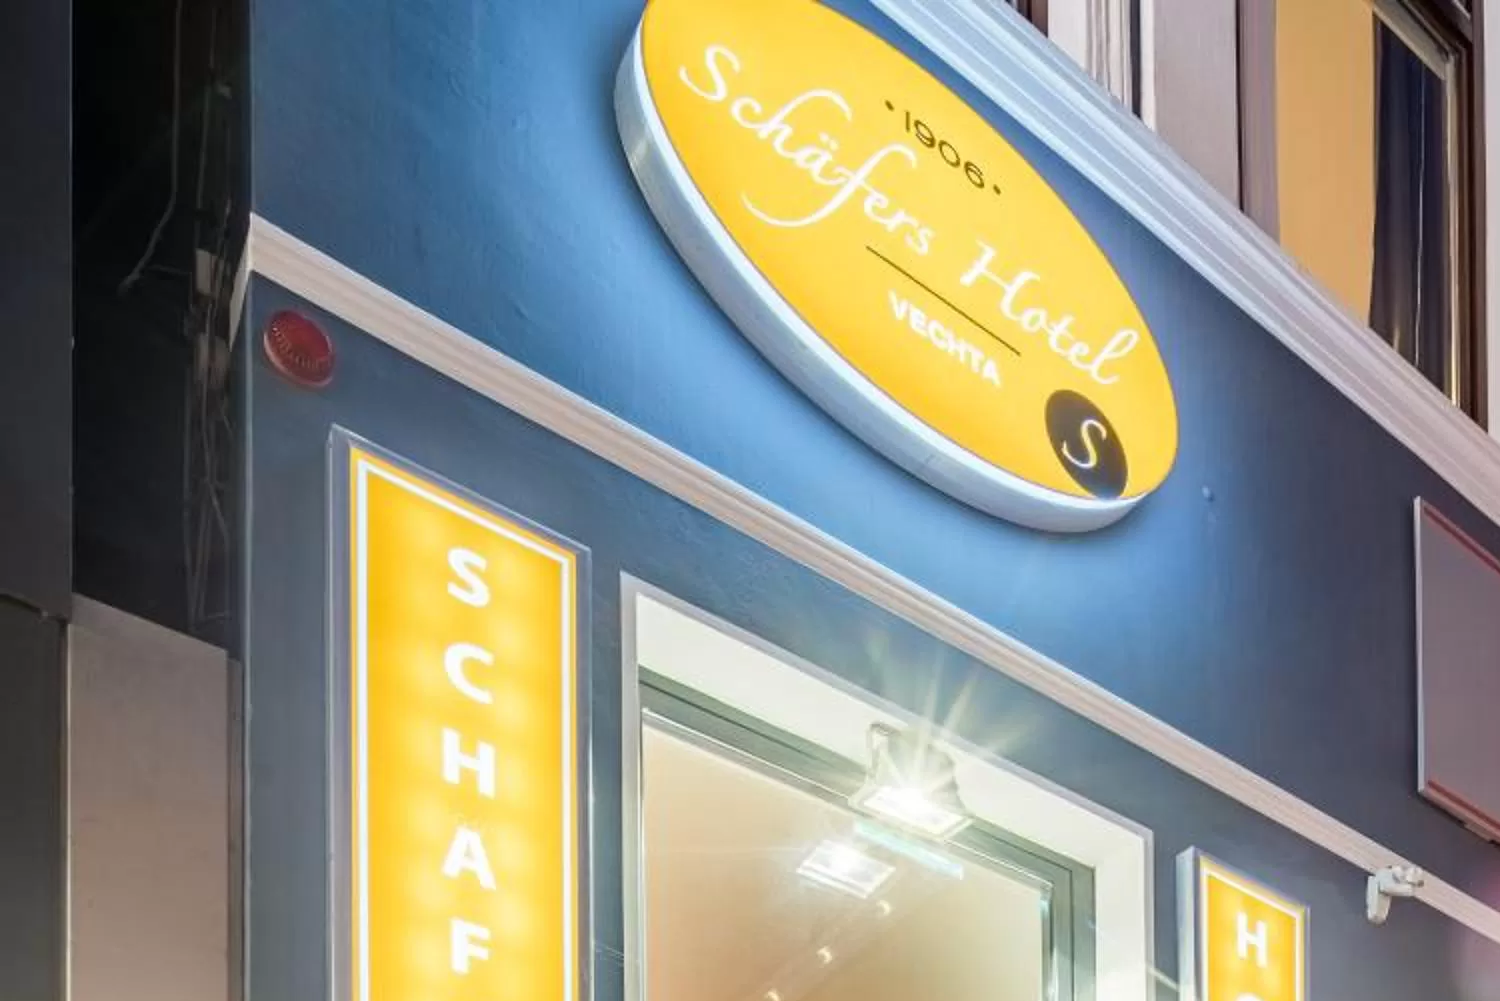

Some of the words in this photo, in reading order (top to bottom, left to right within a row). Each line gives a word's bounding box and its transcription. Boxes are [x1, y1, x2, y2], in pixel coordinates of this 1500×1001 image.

[904, 111, 985, 189] 1906
[679, 45, 936, 257] Schäfers
[960, 240, 1138, 385] Hotel
[889, 290, 1002, 387] VECHTA
